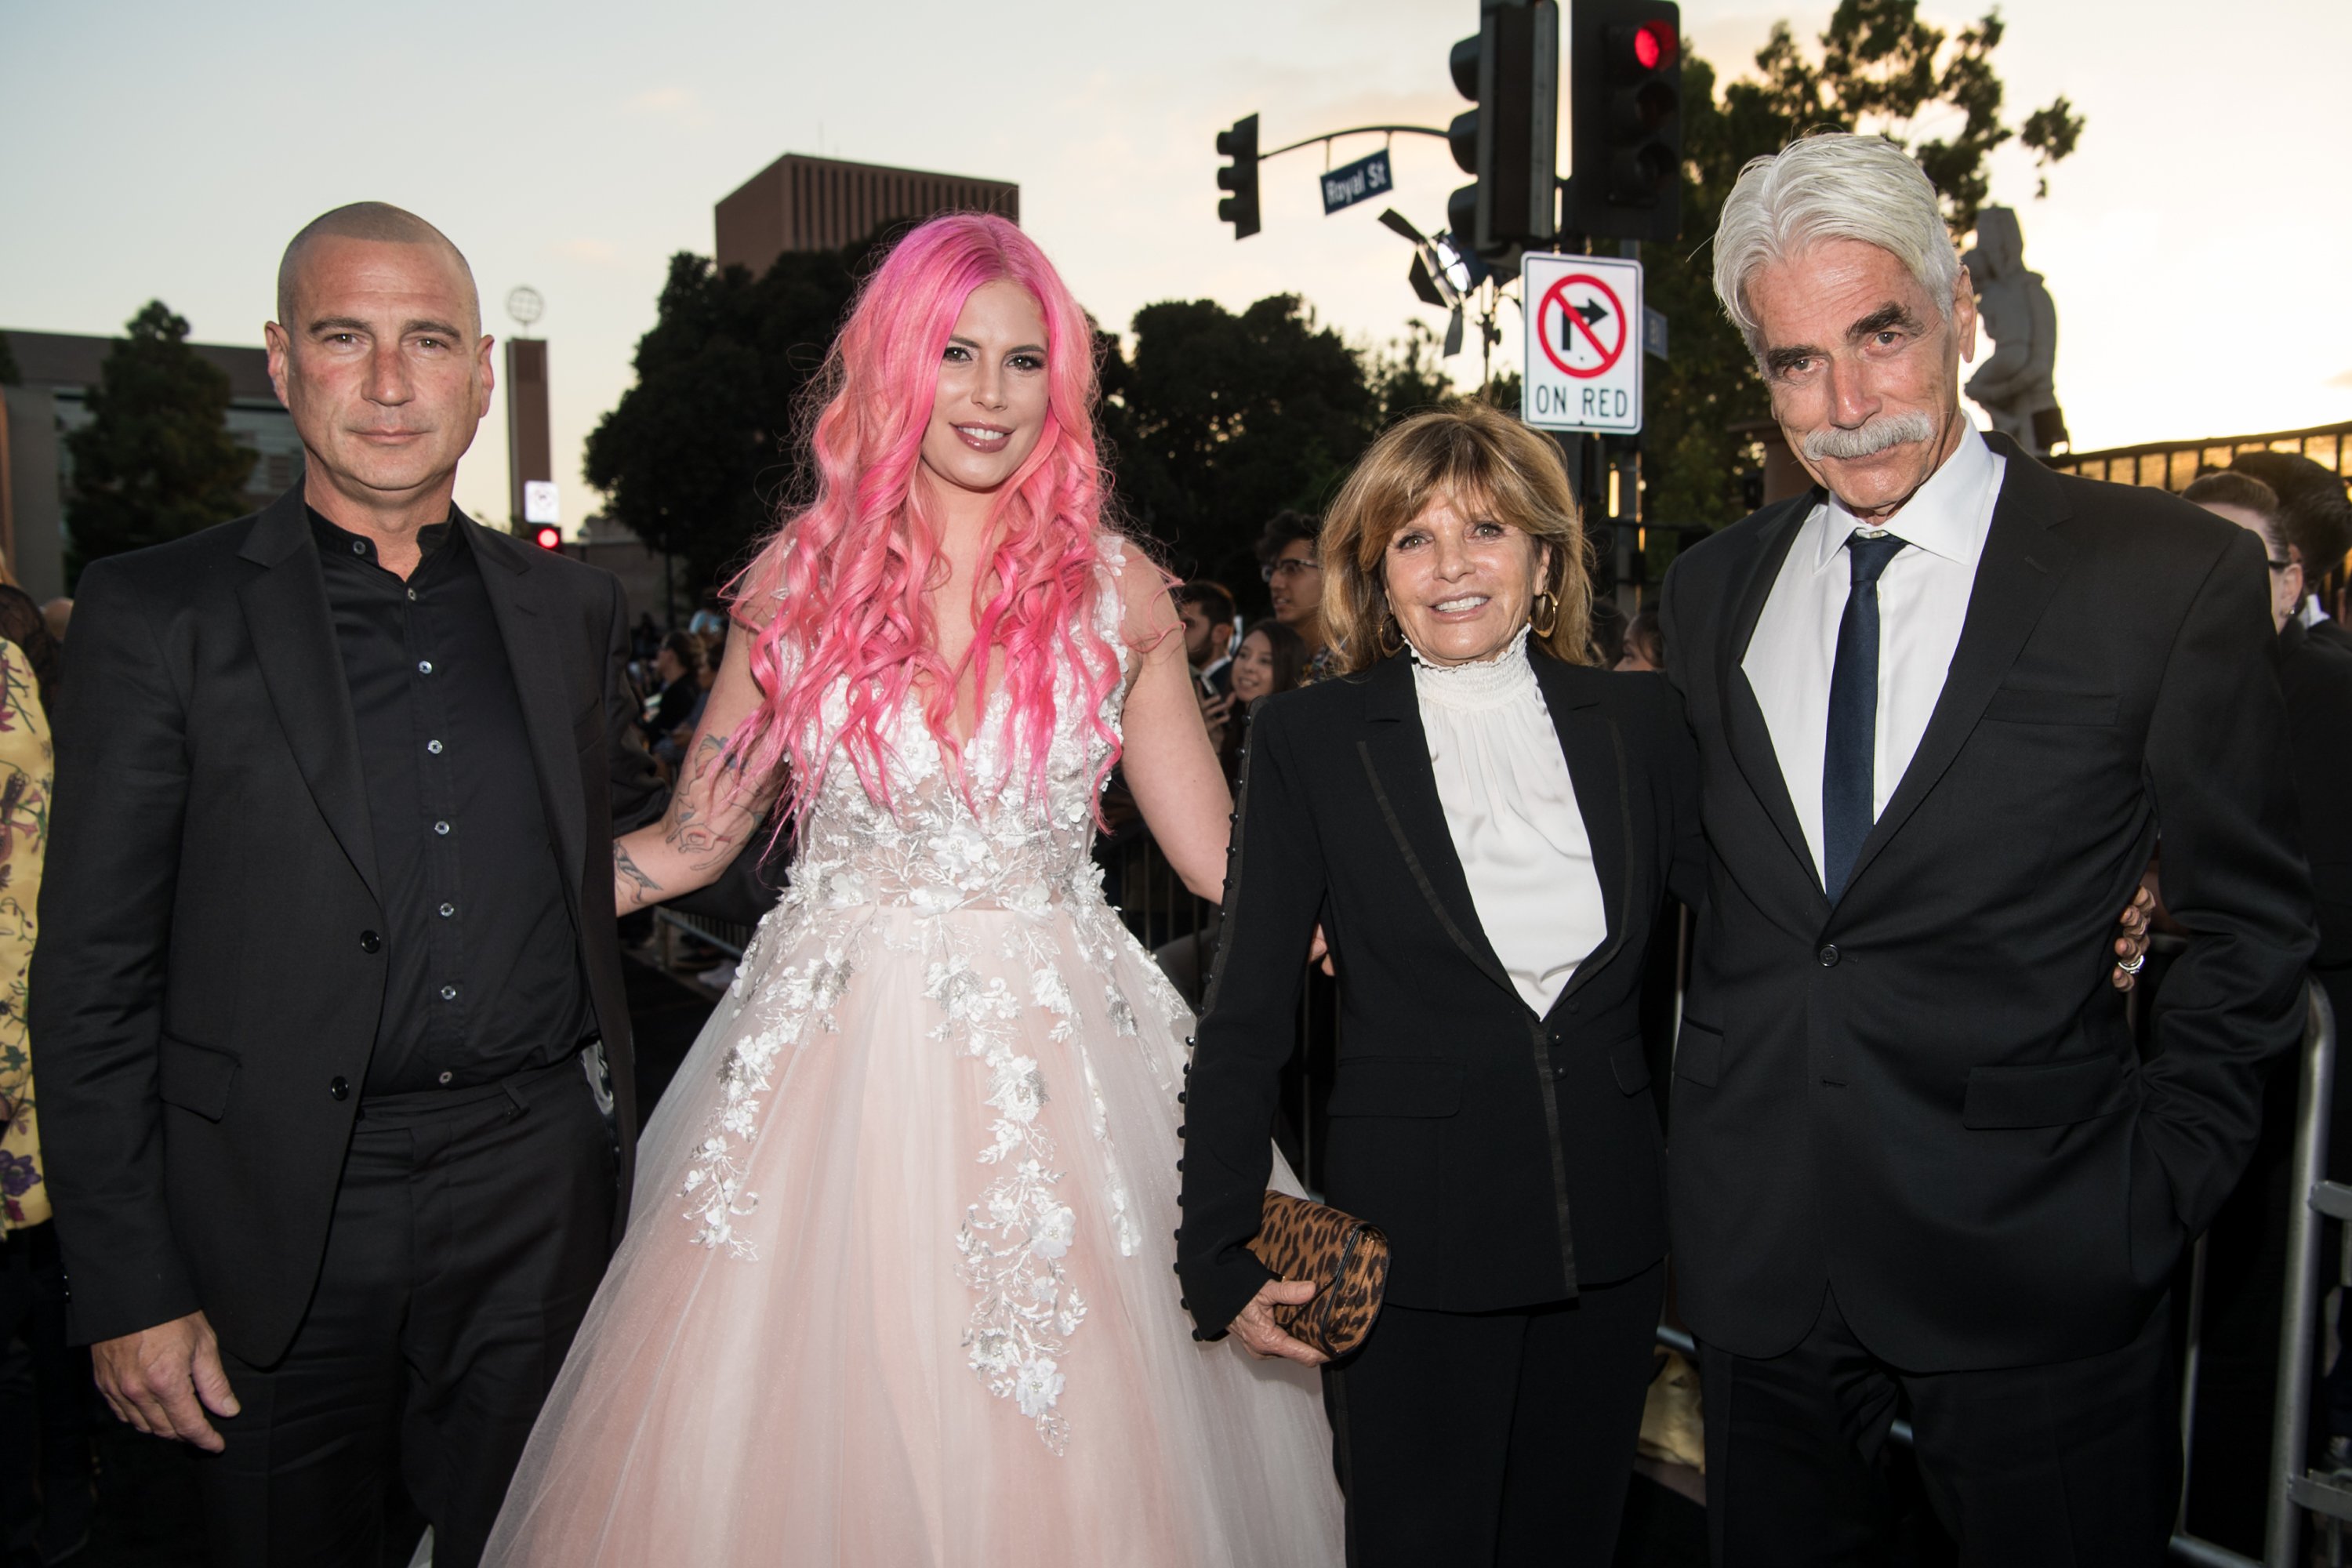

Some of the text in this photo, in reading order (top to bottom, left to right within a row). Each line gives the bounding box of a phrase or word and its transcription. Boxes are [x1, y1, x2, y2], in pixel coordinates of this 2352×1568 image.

[1326, 162, 1386, 205] Royal St
[1536, 385, 1628, 418] ON RED
